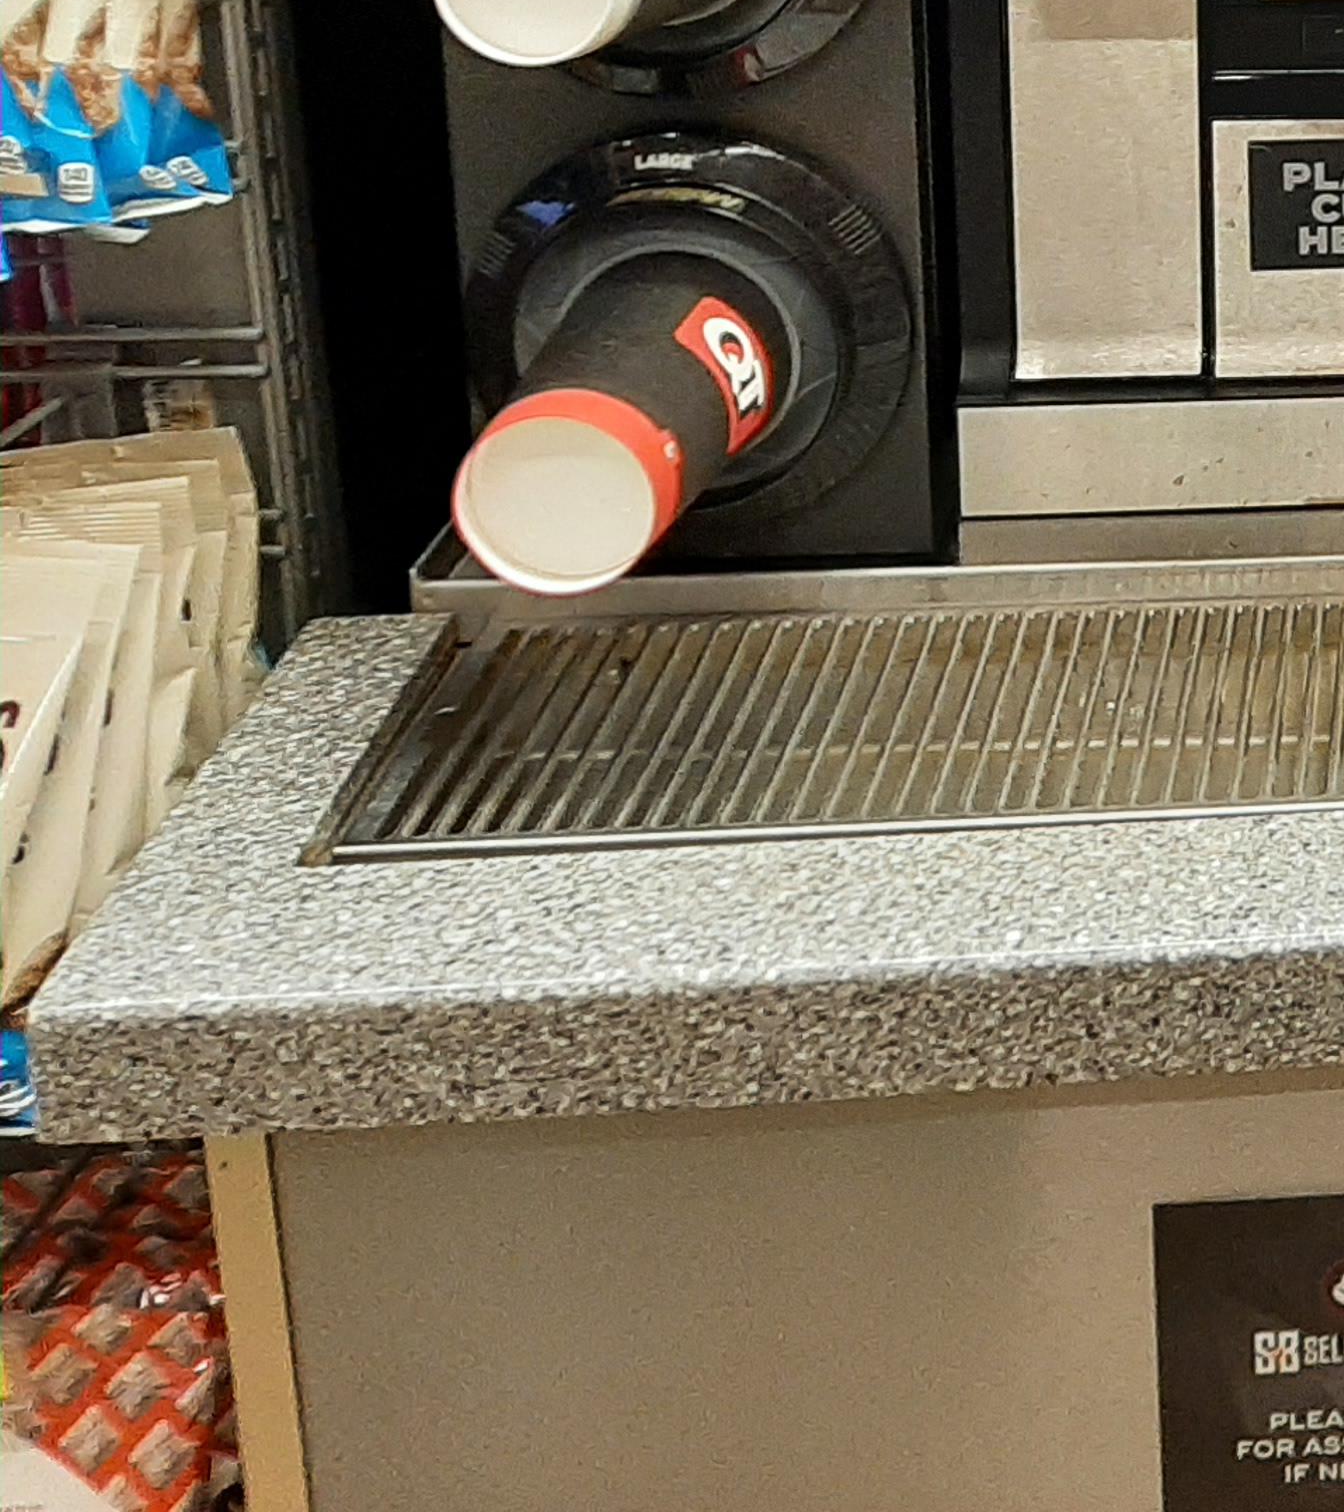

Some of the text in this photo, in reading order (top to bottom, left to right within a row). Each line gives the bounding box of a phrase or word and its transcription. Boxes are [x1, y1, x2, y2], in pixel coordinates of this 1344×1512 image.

[634, 154, 696, 171] LARGE
[1236, 1439, 1296, 1462] FOR
[1283, 1463, 1311, 1484] IF
